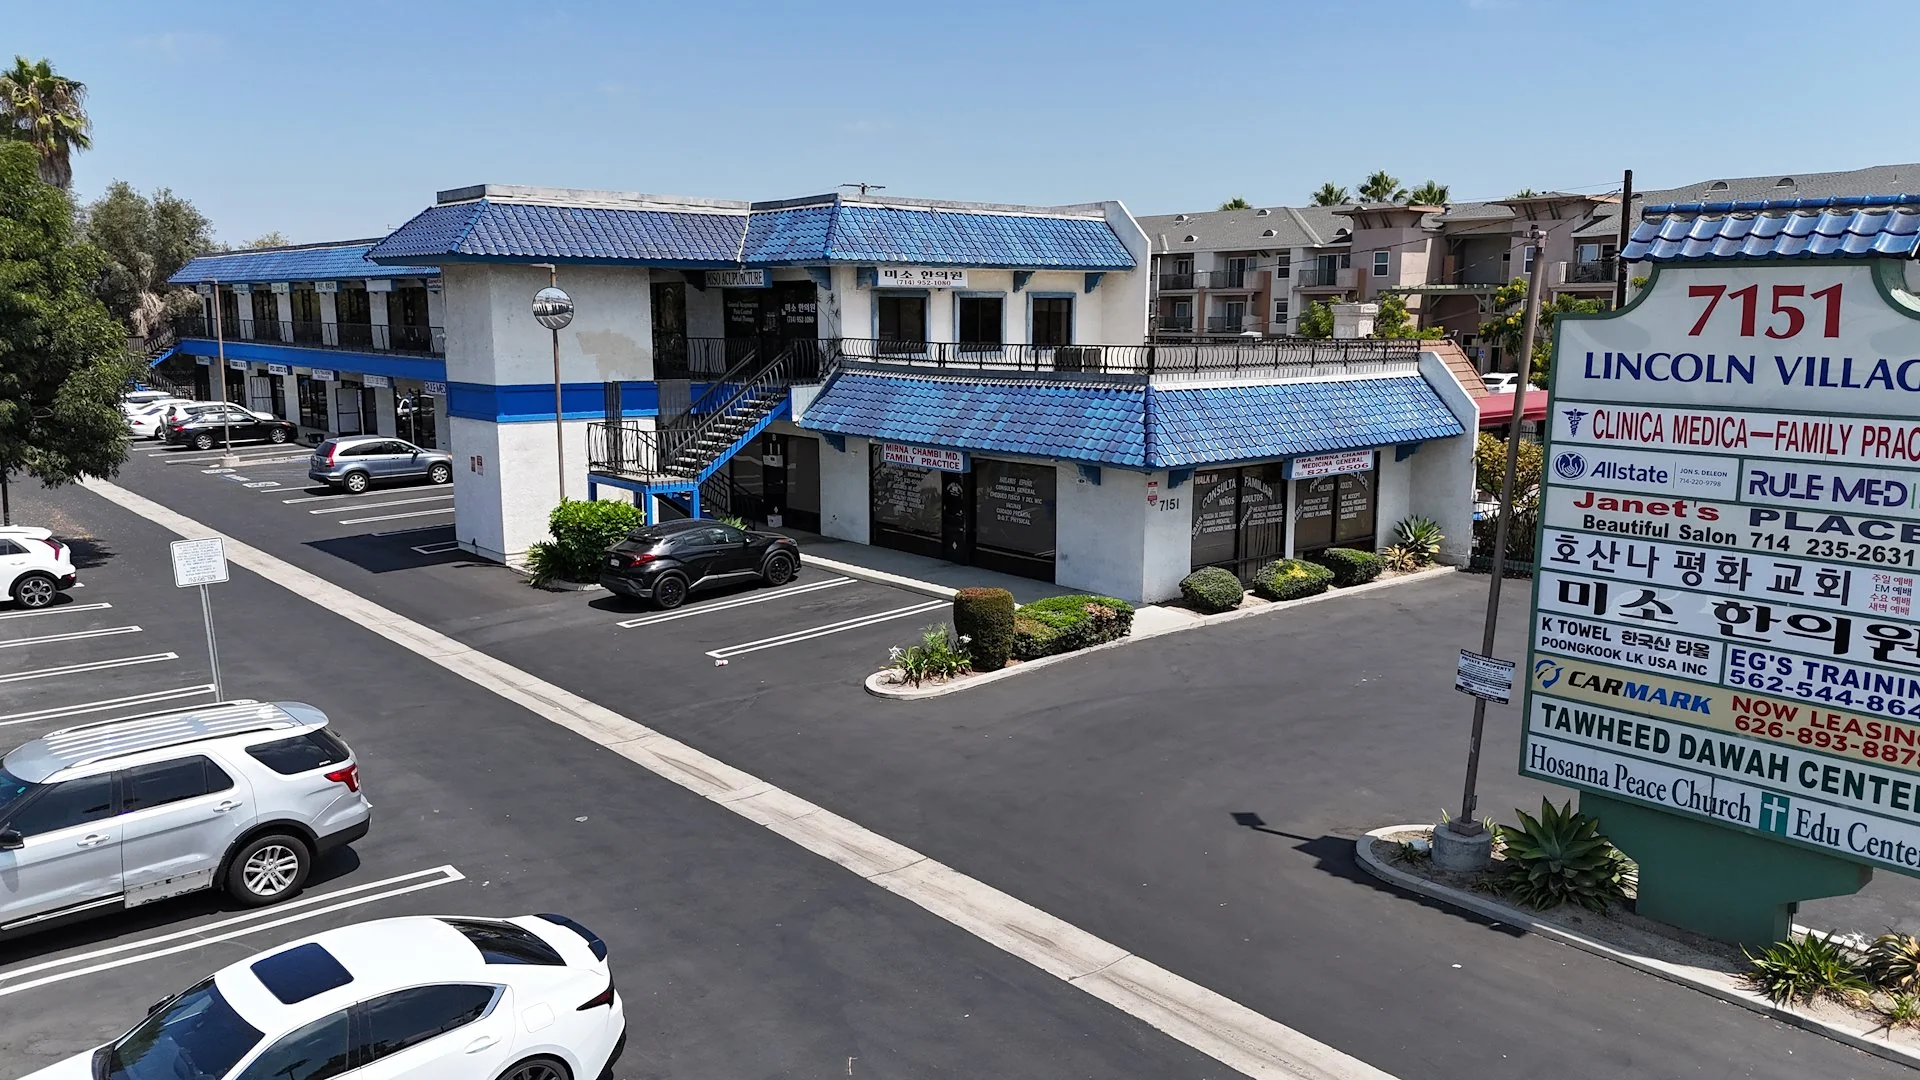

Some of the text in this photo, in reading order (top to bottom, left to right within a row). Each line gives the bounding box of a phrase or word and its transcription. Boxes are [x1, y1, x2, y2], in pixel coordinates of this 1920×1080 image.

[722, 270, 763, 285] ACUPUNCTURE
[884, 270, 963, 280] 미소 한의원
[1688, 282, 1843, 340] 7151
[1584, 352, 1920, 392] LINCOLN VILLAG
[1593, 409, 1664, 443] CLINICA
[1861, 425, 1920, 462] PRAC
[885, 443, 960, 461] MIRNA CHAMBI MD.
[885, 452, 916, 464] FAMILY
[921, 457, 960, 470] PRACTICE
[1301, 456, 1363, 469] MEDICINA GENERAL
[1315, 454, 1339, 462] MIRNA
[1341, 450, 1370, 458] CHAMBI
[1195, 473, 1219, 485] WALK IN
[1307, 462, 1369, 476] 821-6506
[1590, 461, 1668, 484] Allstate
[1202, 476, 1273, 509] CONSULTA FAMILIAR
[1219, 493, 1263, 506] NIÑOS ADULTOS
[1749, 470, 1908, 507] RULE MED
[1160, 498, 1179, 511] 7151
[1573, 491, 1920, 544] Janet's PLACE
[1583, 514, 1915, 567] Beautiful Salon 714 235-2631
[1550, 534, 1852, 606] 호산나 평화 교회
[1872, 573, 1913, 587] 주일 예배
[1869, 593, 1911, 606] 수요 예배
[1875, 584, 1912, 597] EM 예배
[1868, 602, 1910, 616] 새벽 예배
[1542, 617, 1553, 632] K
[1557, 619, 1612, 642] TOWEL
[1621, 630, 1671, 652] 한국산
[1557, 579, 1920, 667] 미소 한의원
[1462, 656, 1512, 672] PRIVATE PROPERTY
[1542, 636, 1708, 676] POONGKOOK LK USA INC
[1730, 648, 1793, 676] EG'S
[1568, 670, 1713, 715] CARMARK
[1732, 695, 1799, 722] NOW
[1541, 702, 1670, 754] TAWHEED
[1678, 733, 1790, 783] DAWAH
[1735, 715, 1920, 769] 626-893-887
[1529, 743, 1920, 868] Hosanna Peace Church Edu Cente
